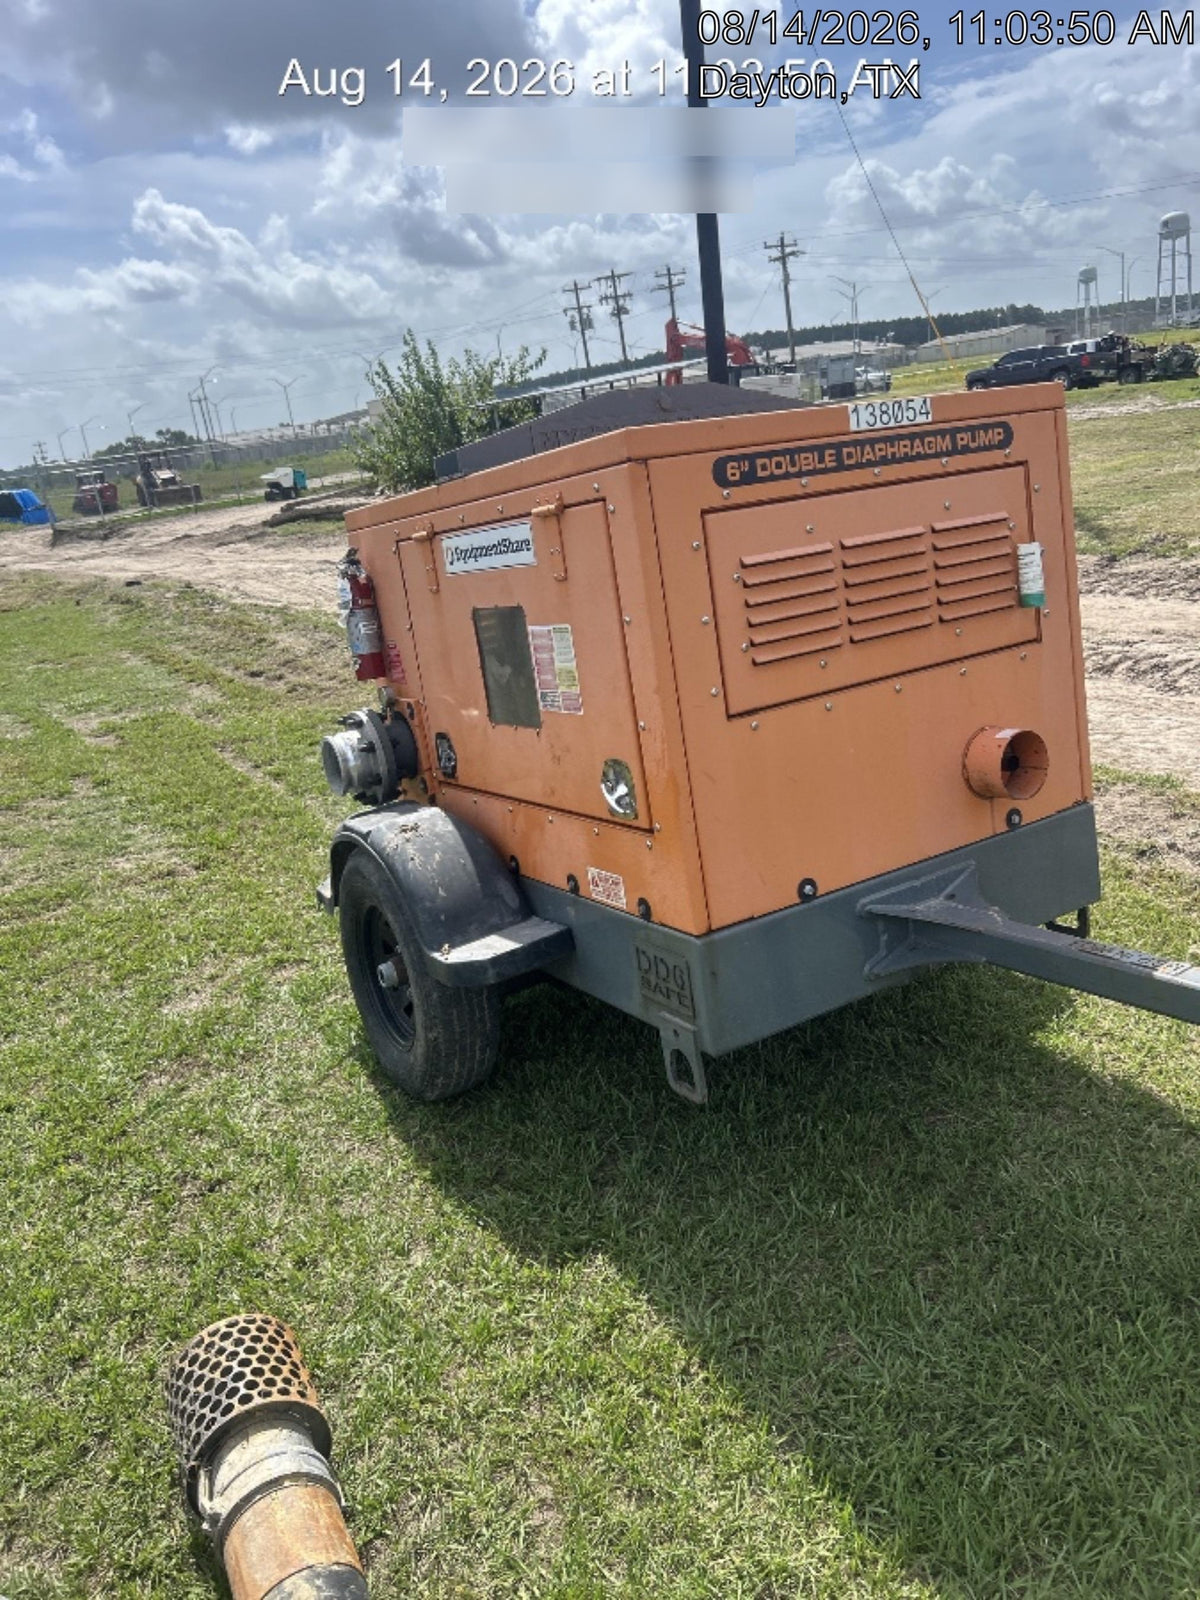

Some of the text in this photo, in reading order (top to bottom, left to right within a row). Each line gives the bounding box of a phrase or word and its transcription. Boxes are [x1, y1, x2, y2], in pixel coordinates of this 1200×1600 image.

[851, 397, 931, 428] 138054
[726, 427, 1004, 481] 6" DOUBLE DIAPHRAGM PUMP
